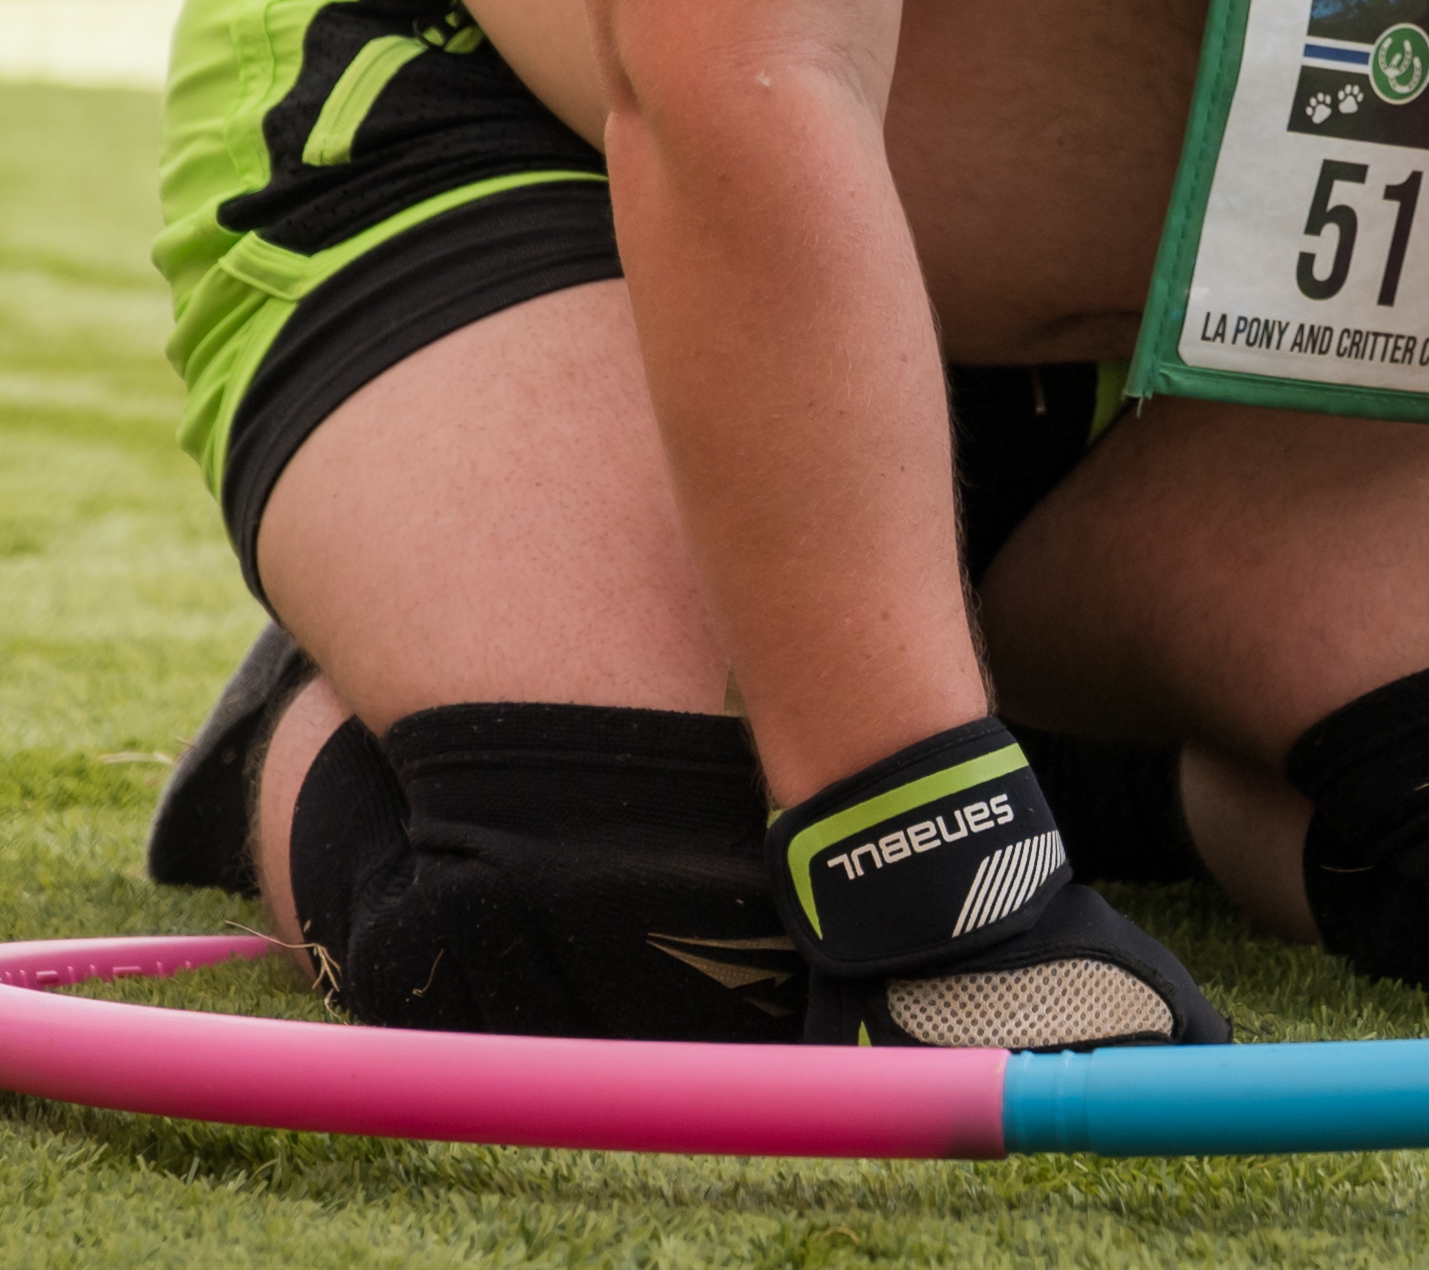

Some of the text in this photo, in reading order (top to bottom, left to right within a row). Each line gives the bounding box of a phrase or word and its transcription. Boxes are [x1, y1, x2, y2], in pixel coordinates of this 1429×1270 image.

[1295, 159, 1423, 307] 51
[1200, 311, 1228, 344] LA
[1231, 315, 1290, 352] PONY
[1290, 323, 1334, 357] AND
[1336, 327, 1418, 366] CRITTER
